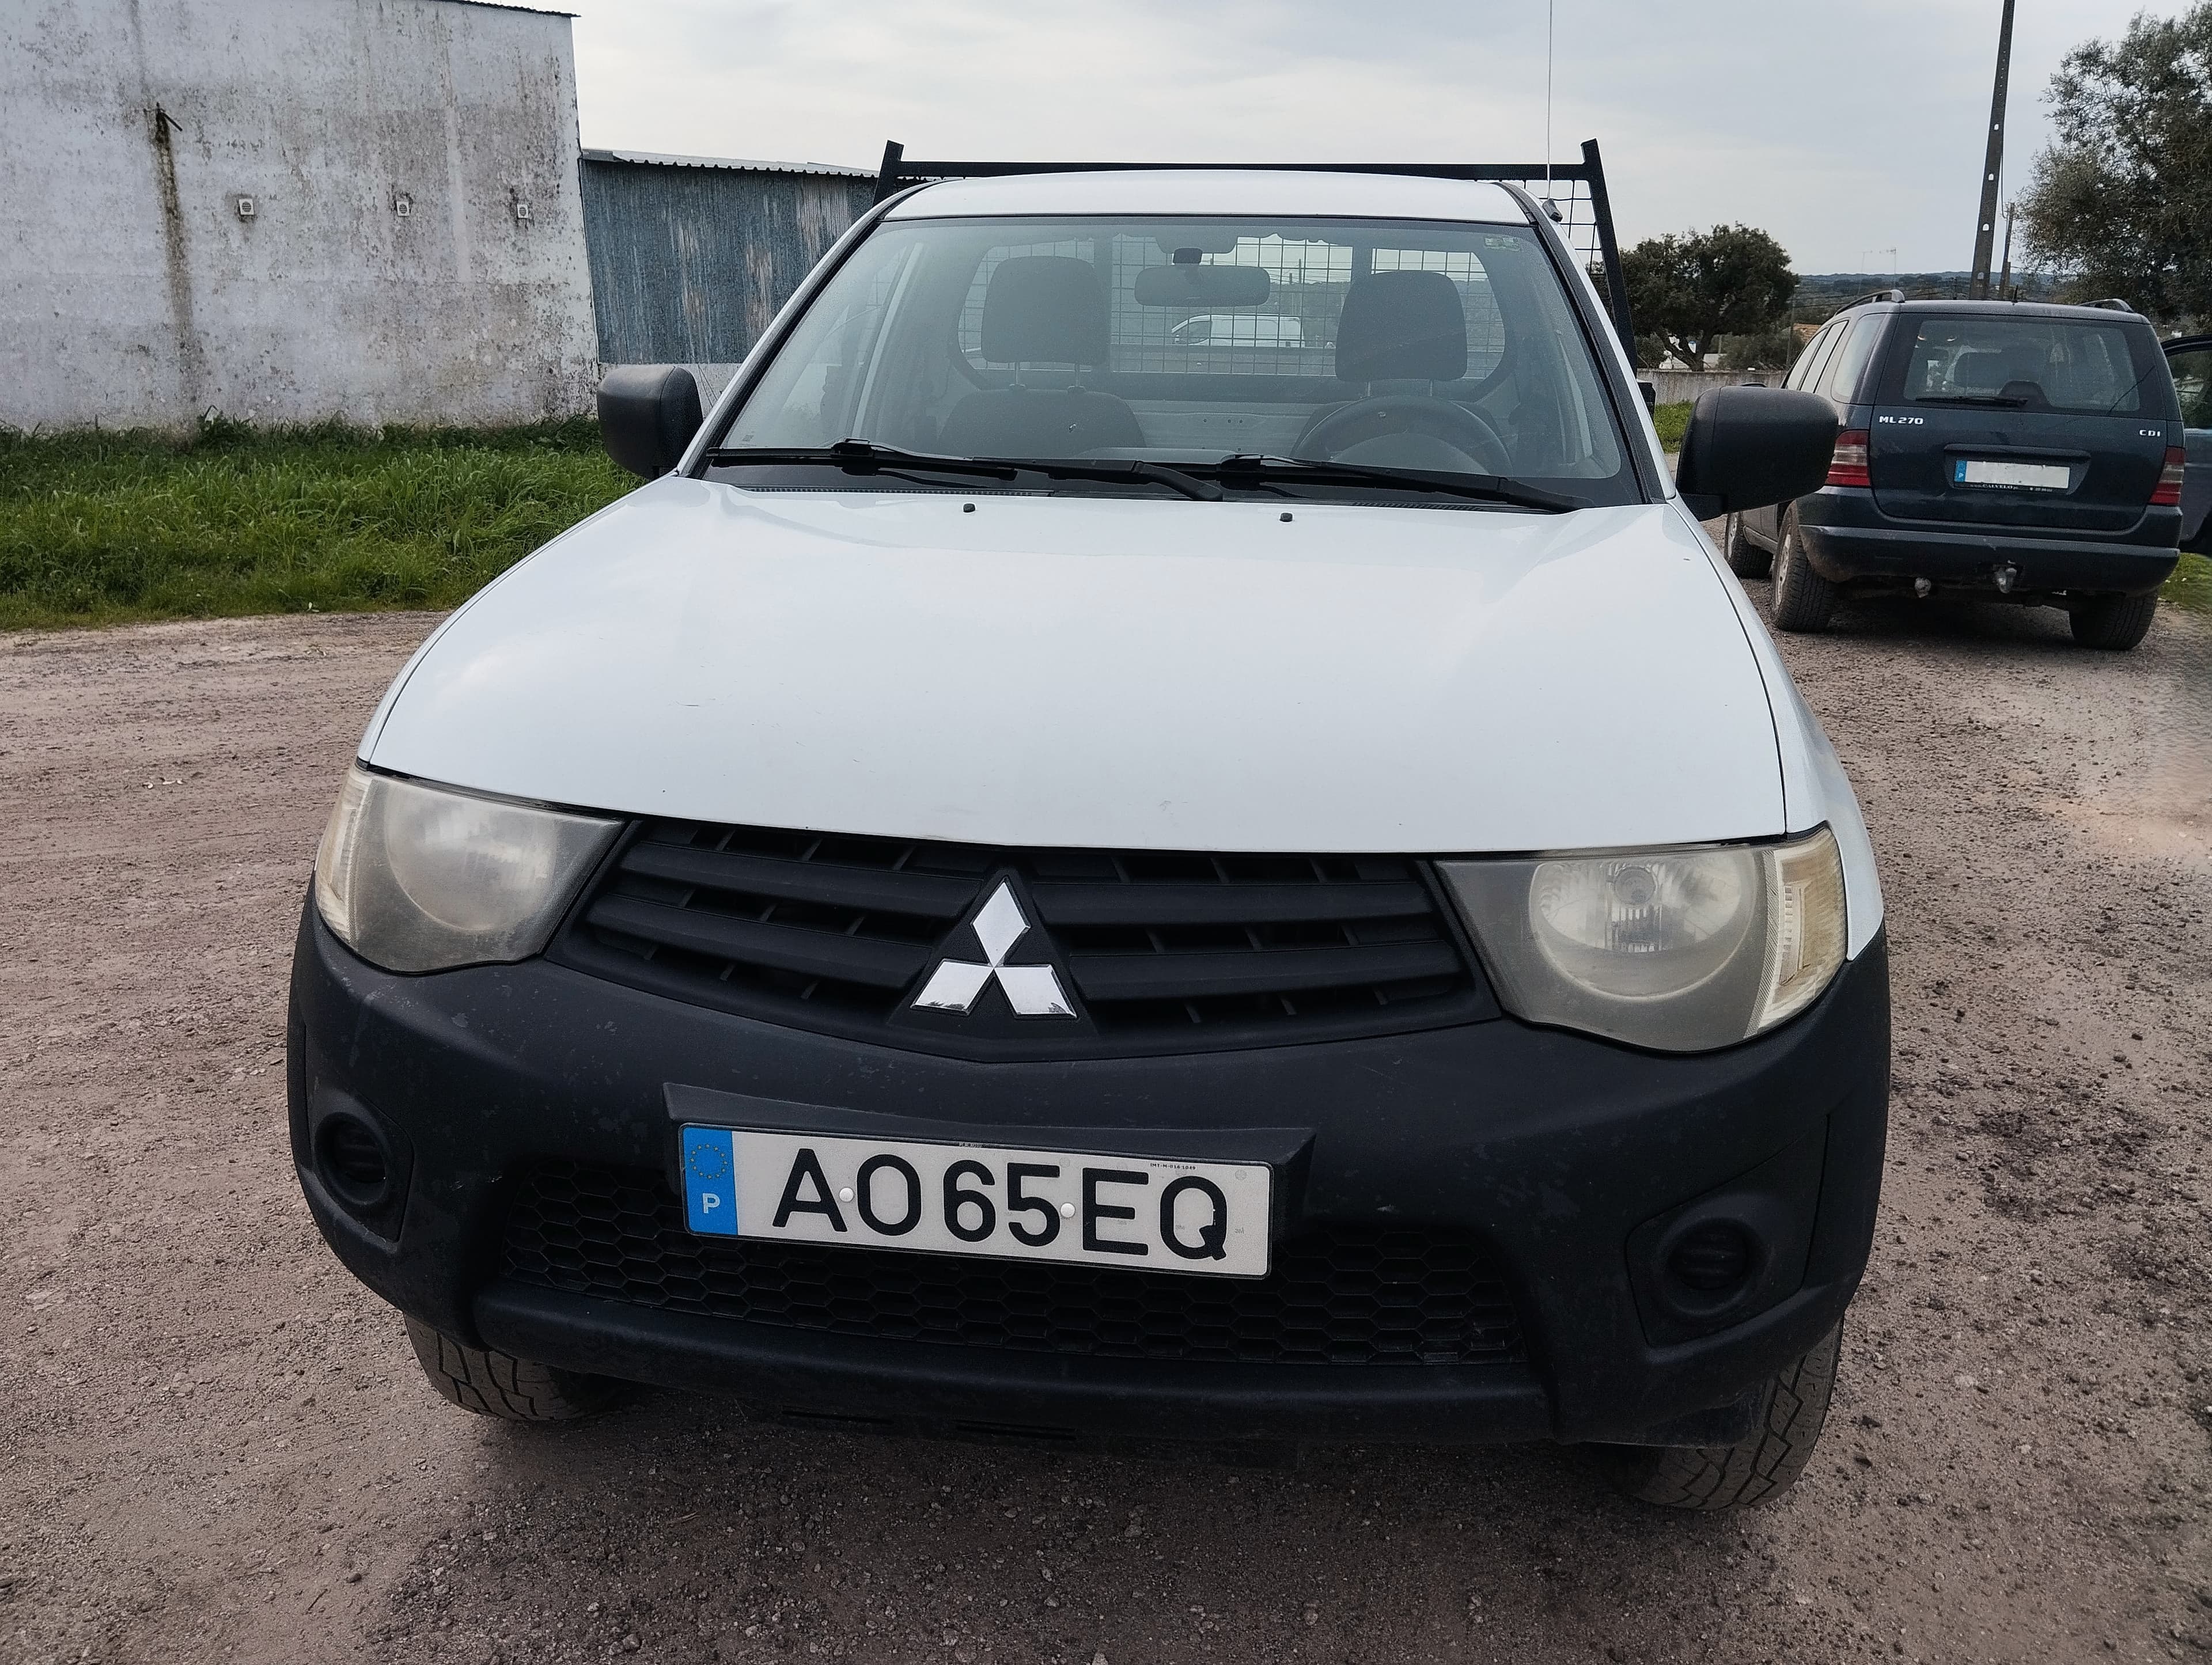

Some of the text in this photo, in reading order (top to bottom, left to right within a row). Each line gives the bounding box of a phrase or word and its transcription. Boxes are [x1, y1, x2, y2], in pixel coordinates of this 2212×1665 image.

[703, 1193, 720, 1213] P
[772, 1148, 1228, 1261] AO 65 EQ
